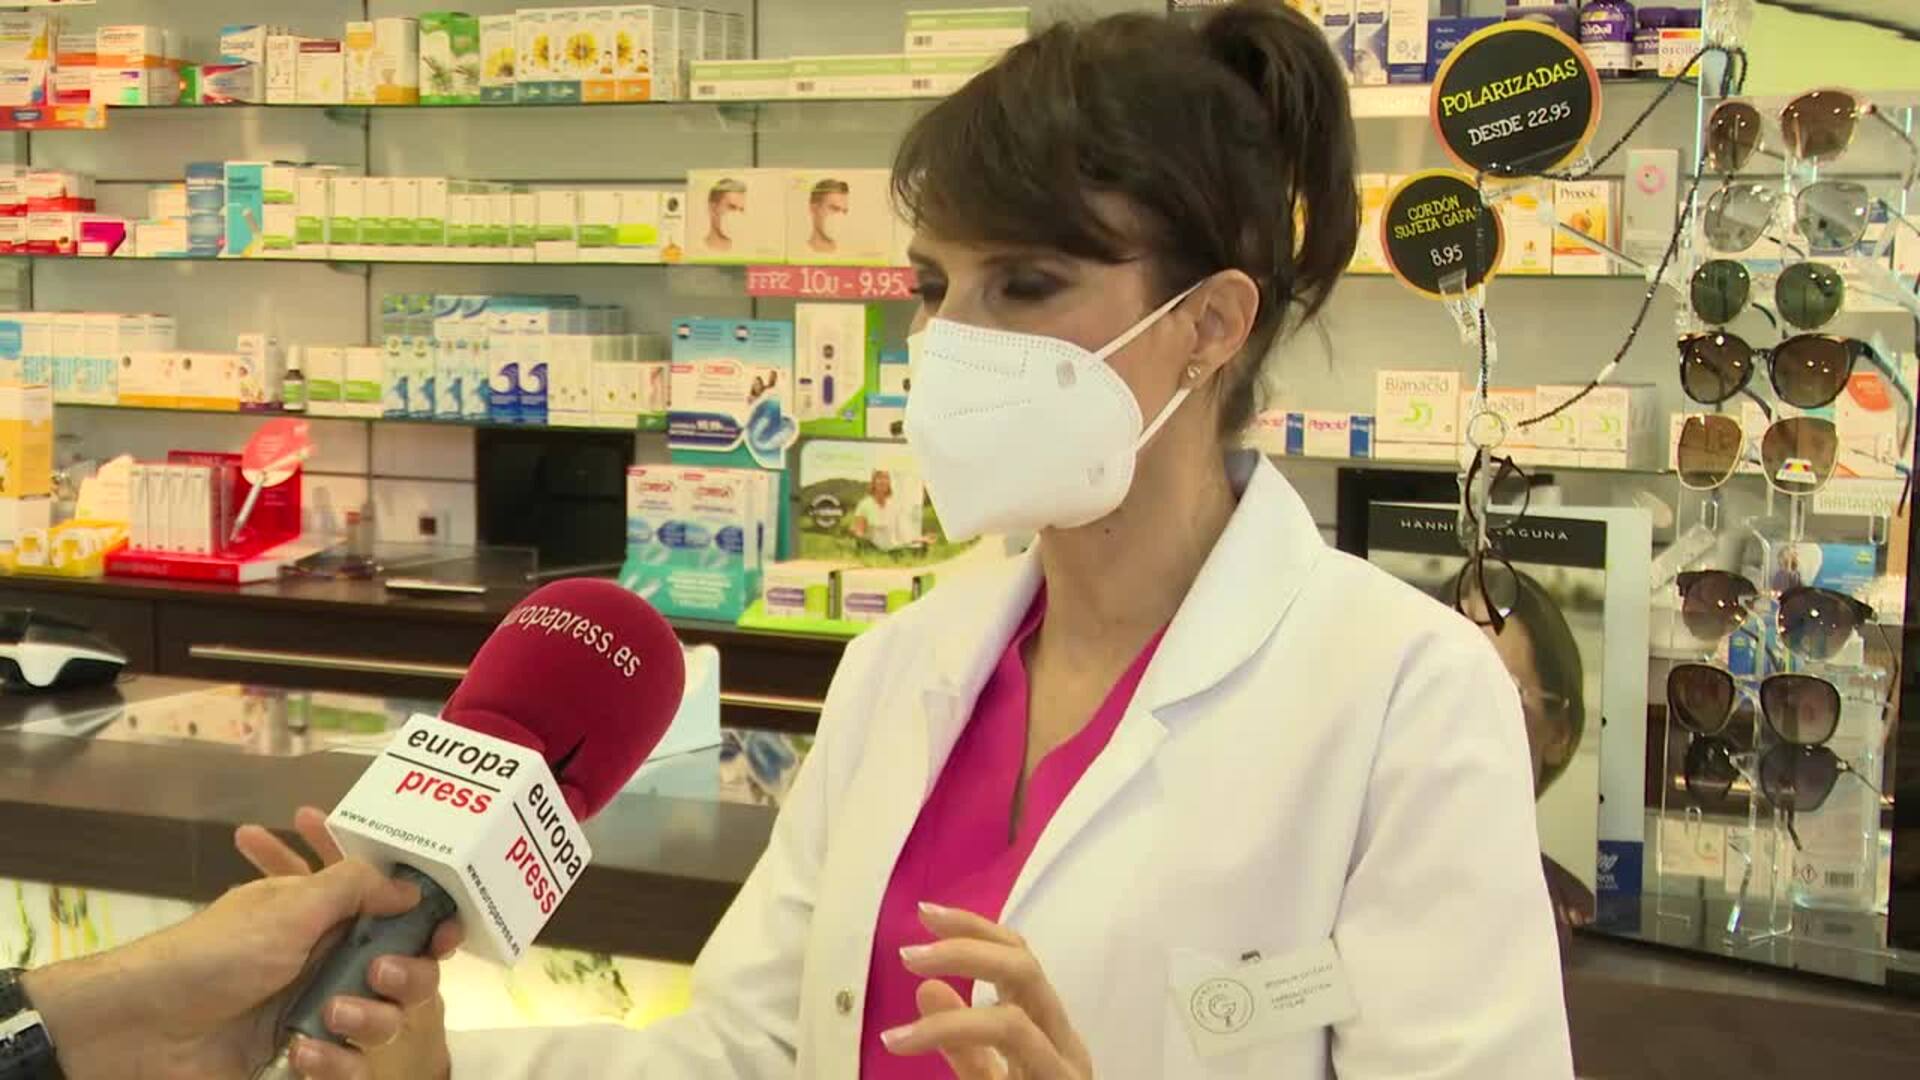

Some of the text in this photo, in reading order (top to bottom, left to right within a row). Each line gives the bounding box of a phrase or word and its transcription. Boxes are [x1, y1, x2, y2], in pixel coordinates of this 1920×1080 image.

[1441, 58, 1579, 117] POLARIZADAS
[1467, 114, 1524, 147] DESDE
[1393, 217, 1441, 239] SUJETA
[1407, 194, 1460, 221] CORDÓN
[748, 271, 793, 290] FFP2
[1401, 519, 1454, 531] HANNI
[503, 604, 641, 677] uropapress.es
[407, 729, 520, 779] europa
[395, 771, 492, 814] press
[528, 783, 582, 880] europa
[505, 835, 556, 914] press
